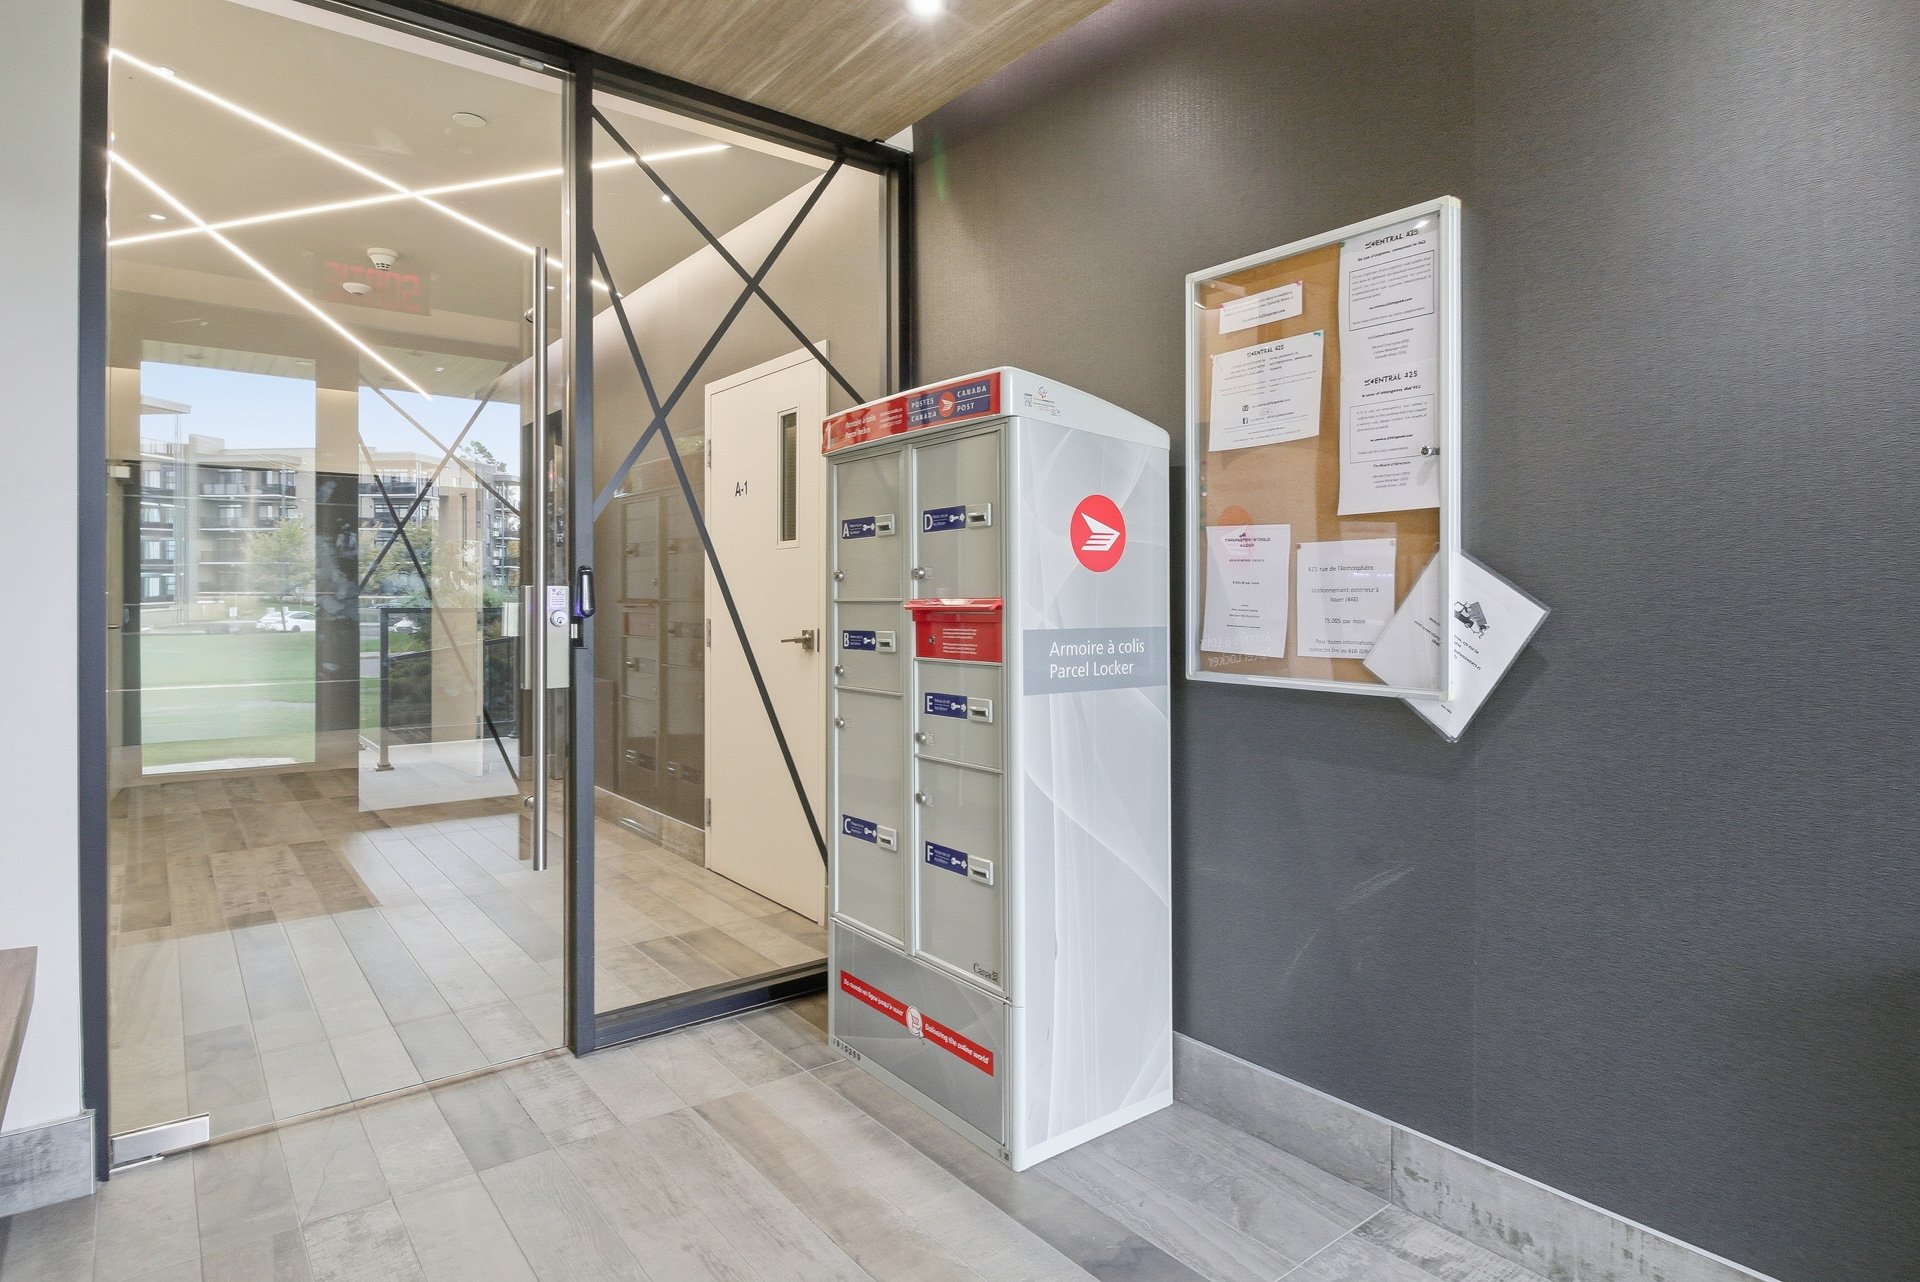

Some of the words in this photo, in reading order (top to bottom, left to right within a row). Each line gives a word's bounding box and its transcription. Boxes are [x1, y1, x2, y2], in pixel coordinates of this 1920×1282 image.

[957, 384, 987, 398] CANADA
[911, 397, 934, 409] POSTES
[957, 402, 975, 412] POST
[911, 411, 937, 422] CANADA
[825, 422, 832, 449] 1
[735, 480, 748, 496] A-1
[924, 513, 934, 530] D
[843, 523, 850, 537] A
[843, 632, 850, 647] B
[1049, 640, 1104, 657] Armoire
[1107, 639, 1115, 654] à
[1118, 638, 1145, 654] colis
[1050, 661, 1089, 679] Parcel
[1093, 659, 1134, 676] Locker
[926, 695, 934, 712] E
[845, 818, 851, 833] C
[927, 845, 934, 861] F
[948, 1036, 957, 1047] the
[957, 1043, 973, 1055] online
